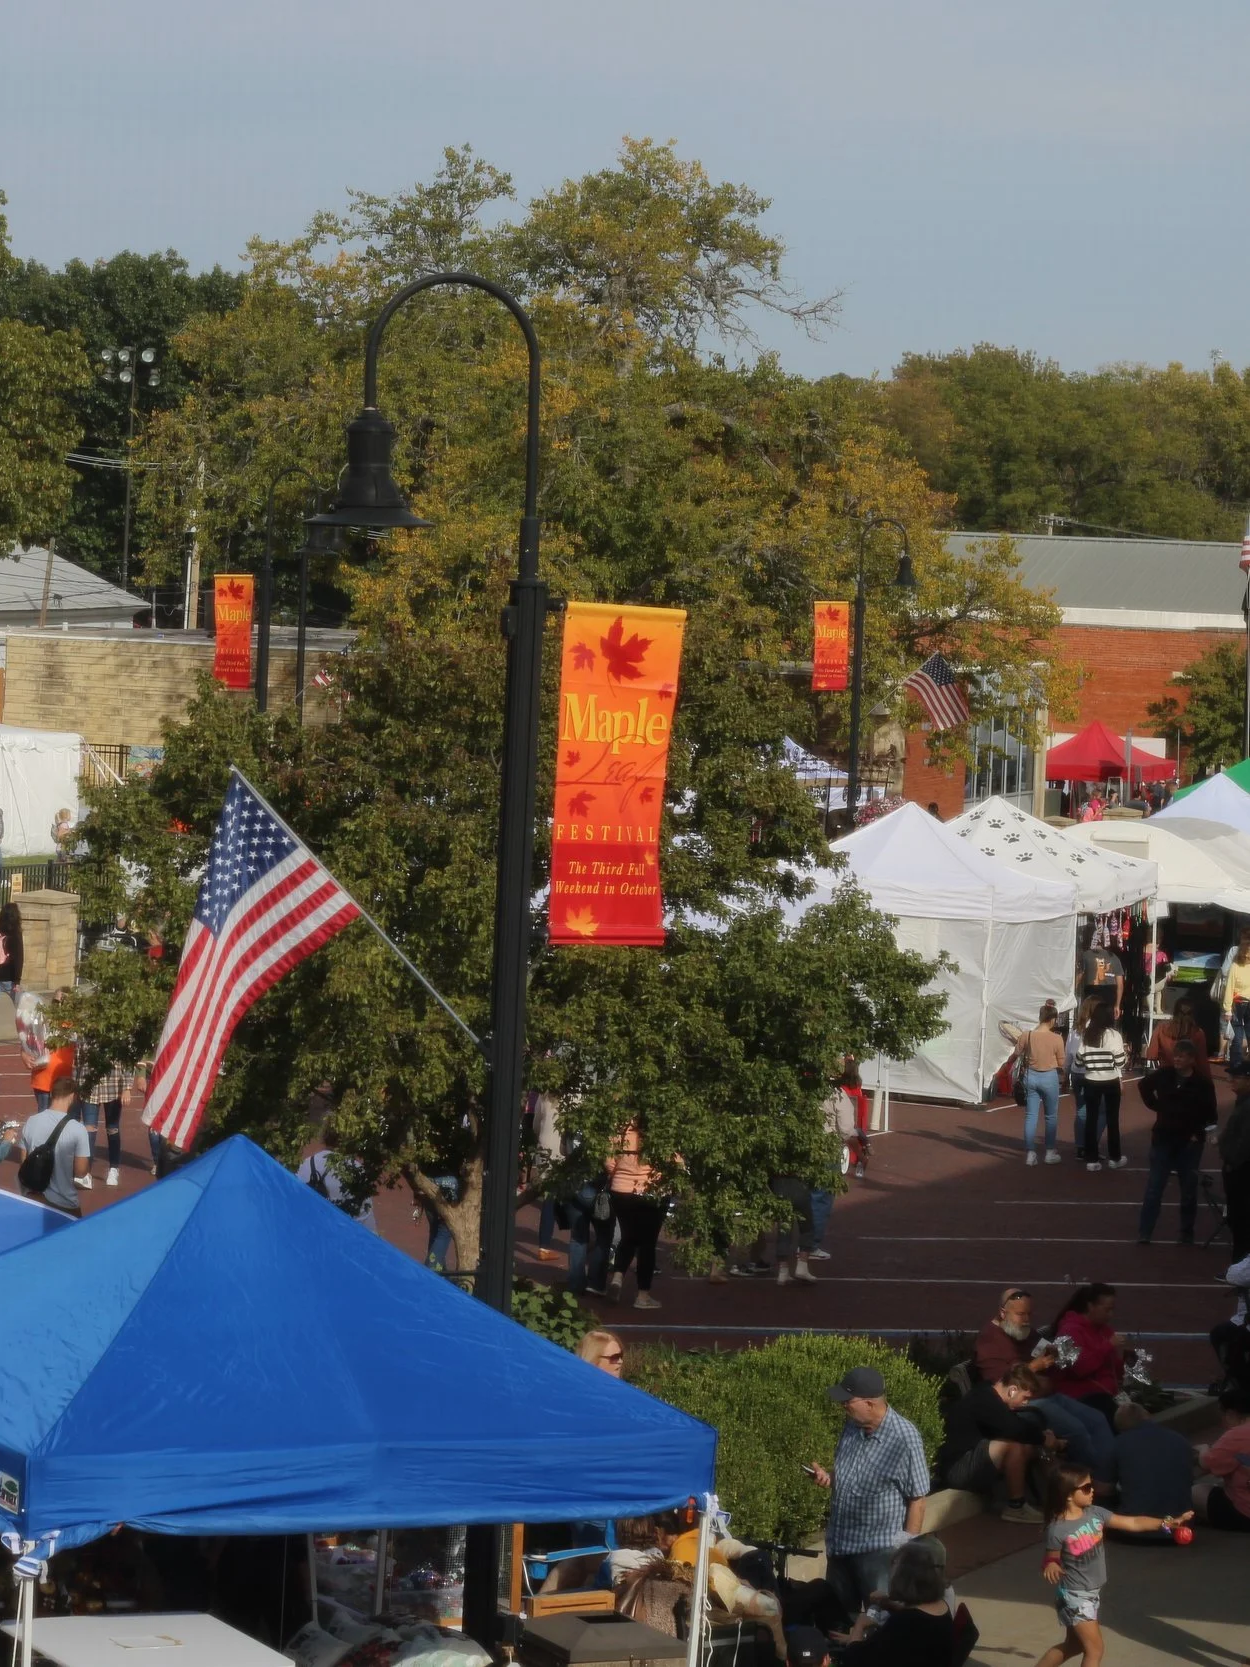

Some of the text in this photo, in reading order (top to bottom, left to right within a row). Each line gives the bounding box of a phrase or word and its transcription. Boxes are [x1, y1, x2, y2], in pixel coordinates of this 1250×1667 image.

[216, 604, 251, 624] Maple
[816, 625, 847, 640] Maple
[561, 693, 668, 754] Maple
[556, 824, 657, 842] FESTIVAL
[568, 861, 645, 876] The Third Fall
[555, 880, 658, 896] Weekend in October
